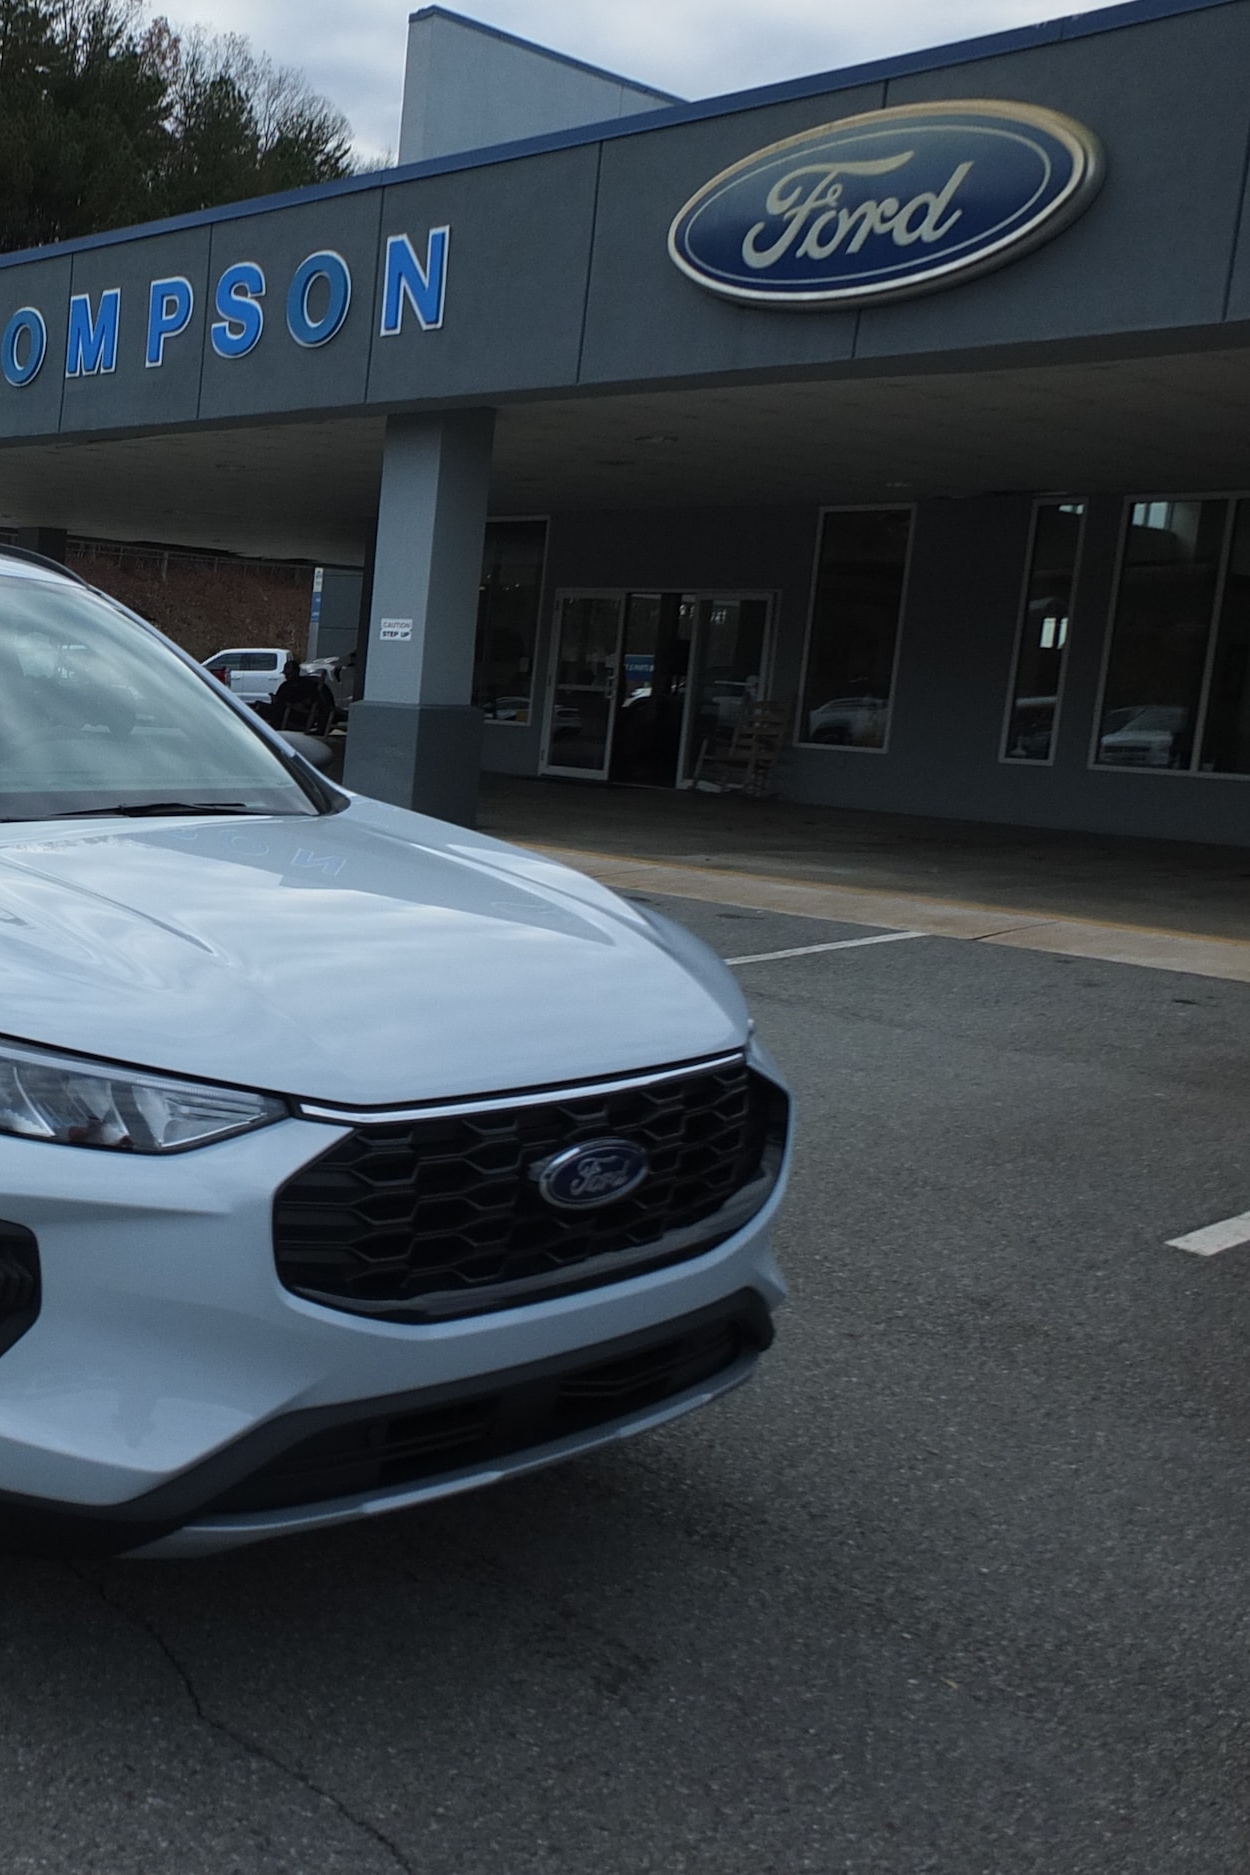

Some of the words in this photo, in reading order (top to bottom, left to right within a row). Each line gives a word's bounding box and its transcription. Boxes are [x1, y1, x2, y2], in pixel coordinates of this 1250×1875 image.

[741, 150, 974, 269] Ford
[382, 621, 410, 629] CAUTION
[382, 630, 399, 638] STEP
[570, 1155, 629, 1196] Ford
